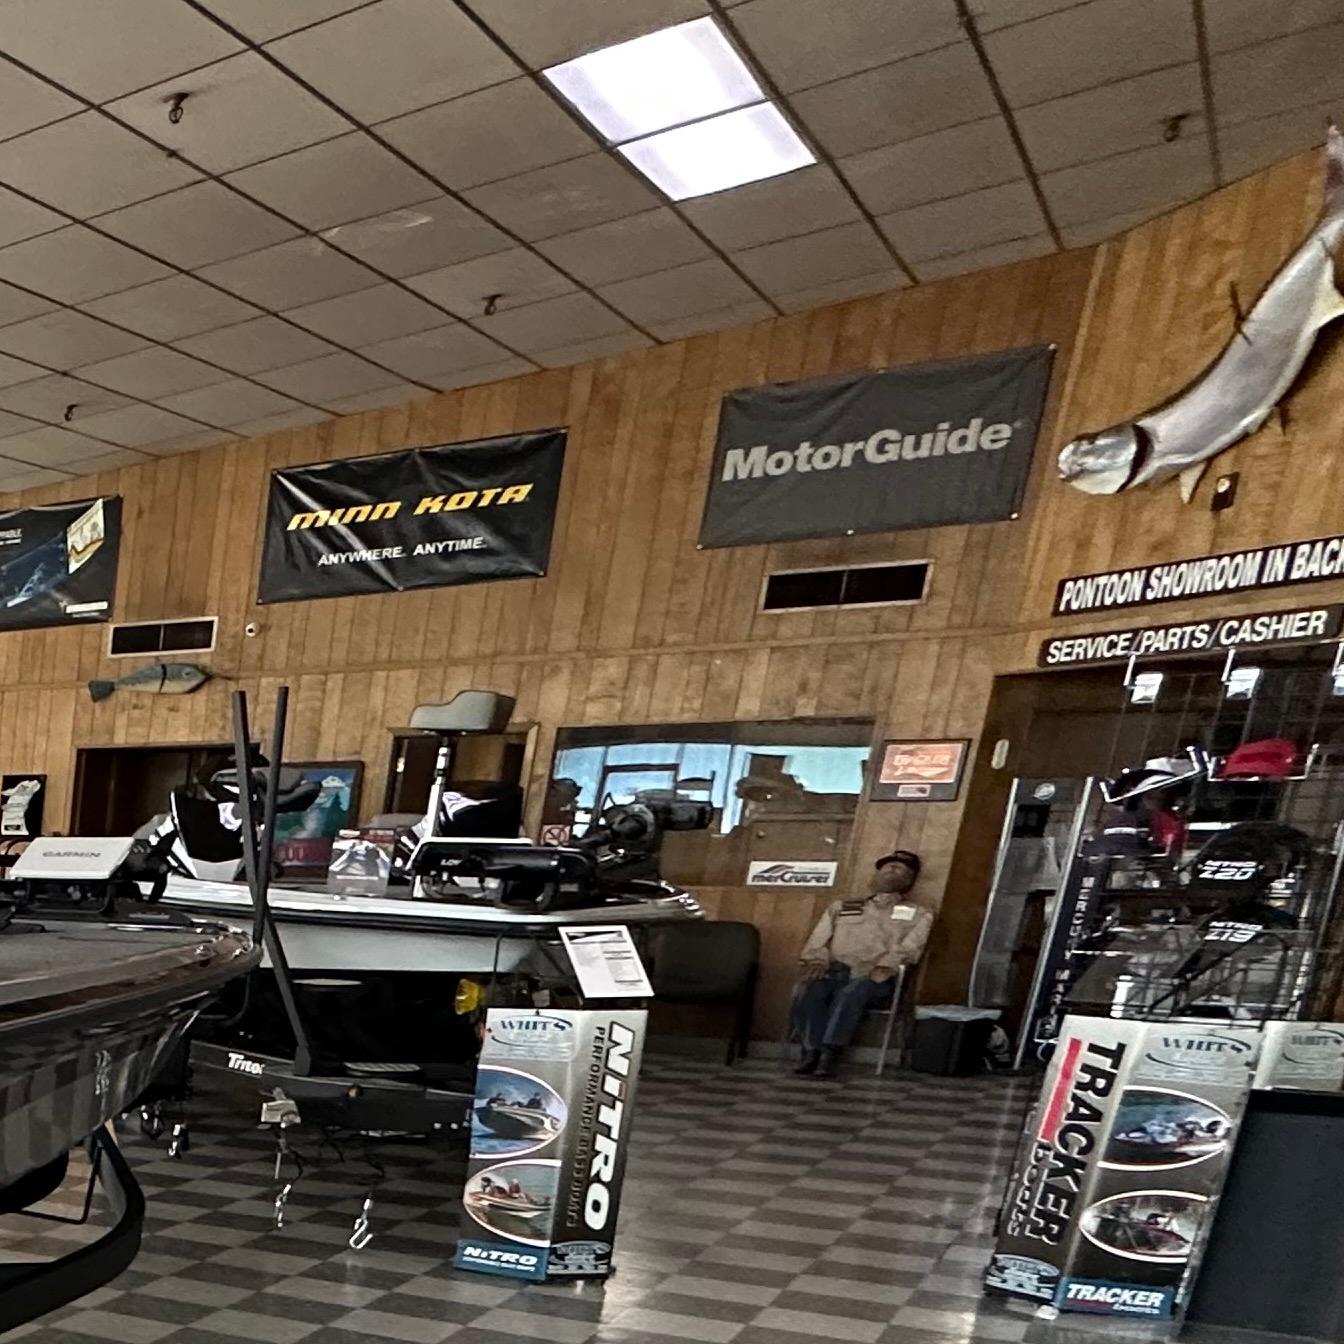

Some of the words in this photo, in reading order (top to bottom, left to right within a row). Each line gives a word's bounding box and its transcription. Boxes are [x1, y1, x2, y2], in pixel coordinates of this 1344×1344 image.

[720, 417, 1013, 482] MotorGuide
[286, 500, 403, 532] MINN
[413, 482, 535, 517] KOTA
[413, 536, 487, 557] ANYTIME.
[1058, 569, 1148, 613] PONTOON
[1146, 550, 1264, 602] SHOWROOM
[1261, 547, 1292, 585] IN
[41, 849, 103, 860] GARMIN
[1198, 866, 1256, 881] Z20
[1063, 876, 1096, 961] MERCUY
[1024, 1042, 1127, 1246] TRACKER
[1066, 1283, 1165, 1308] TRACKER
